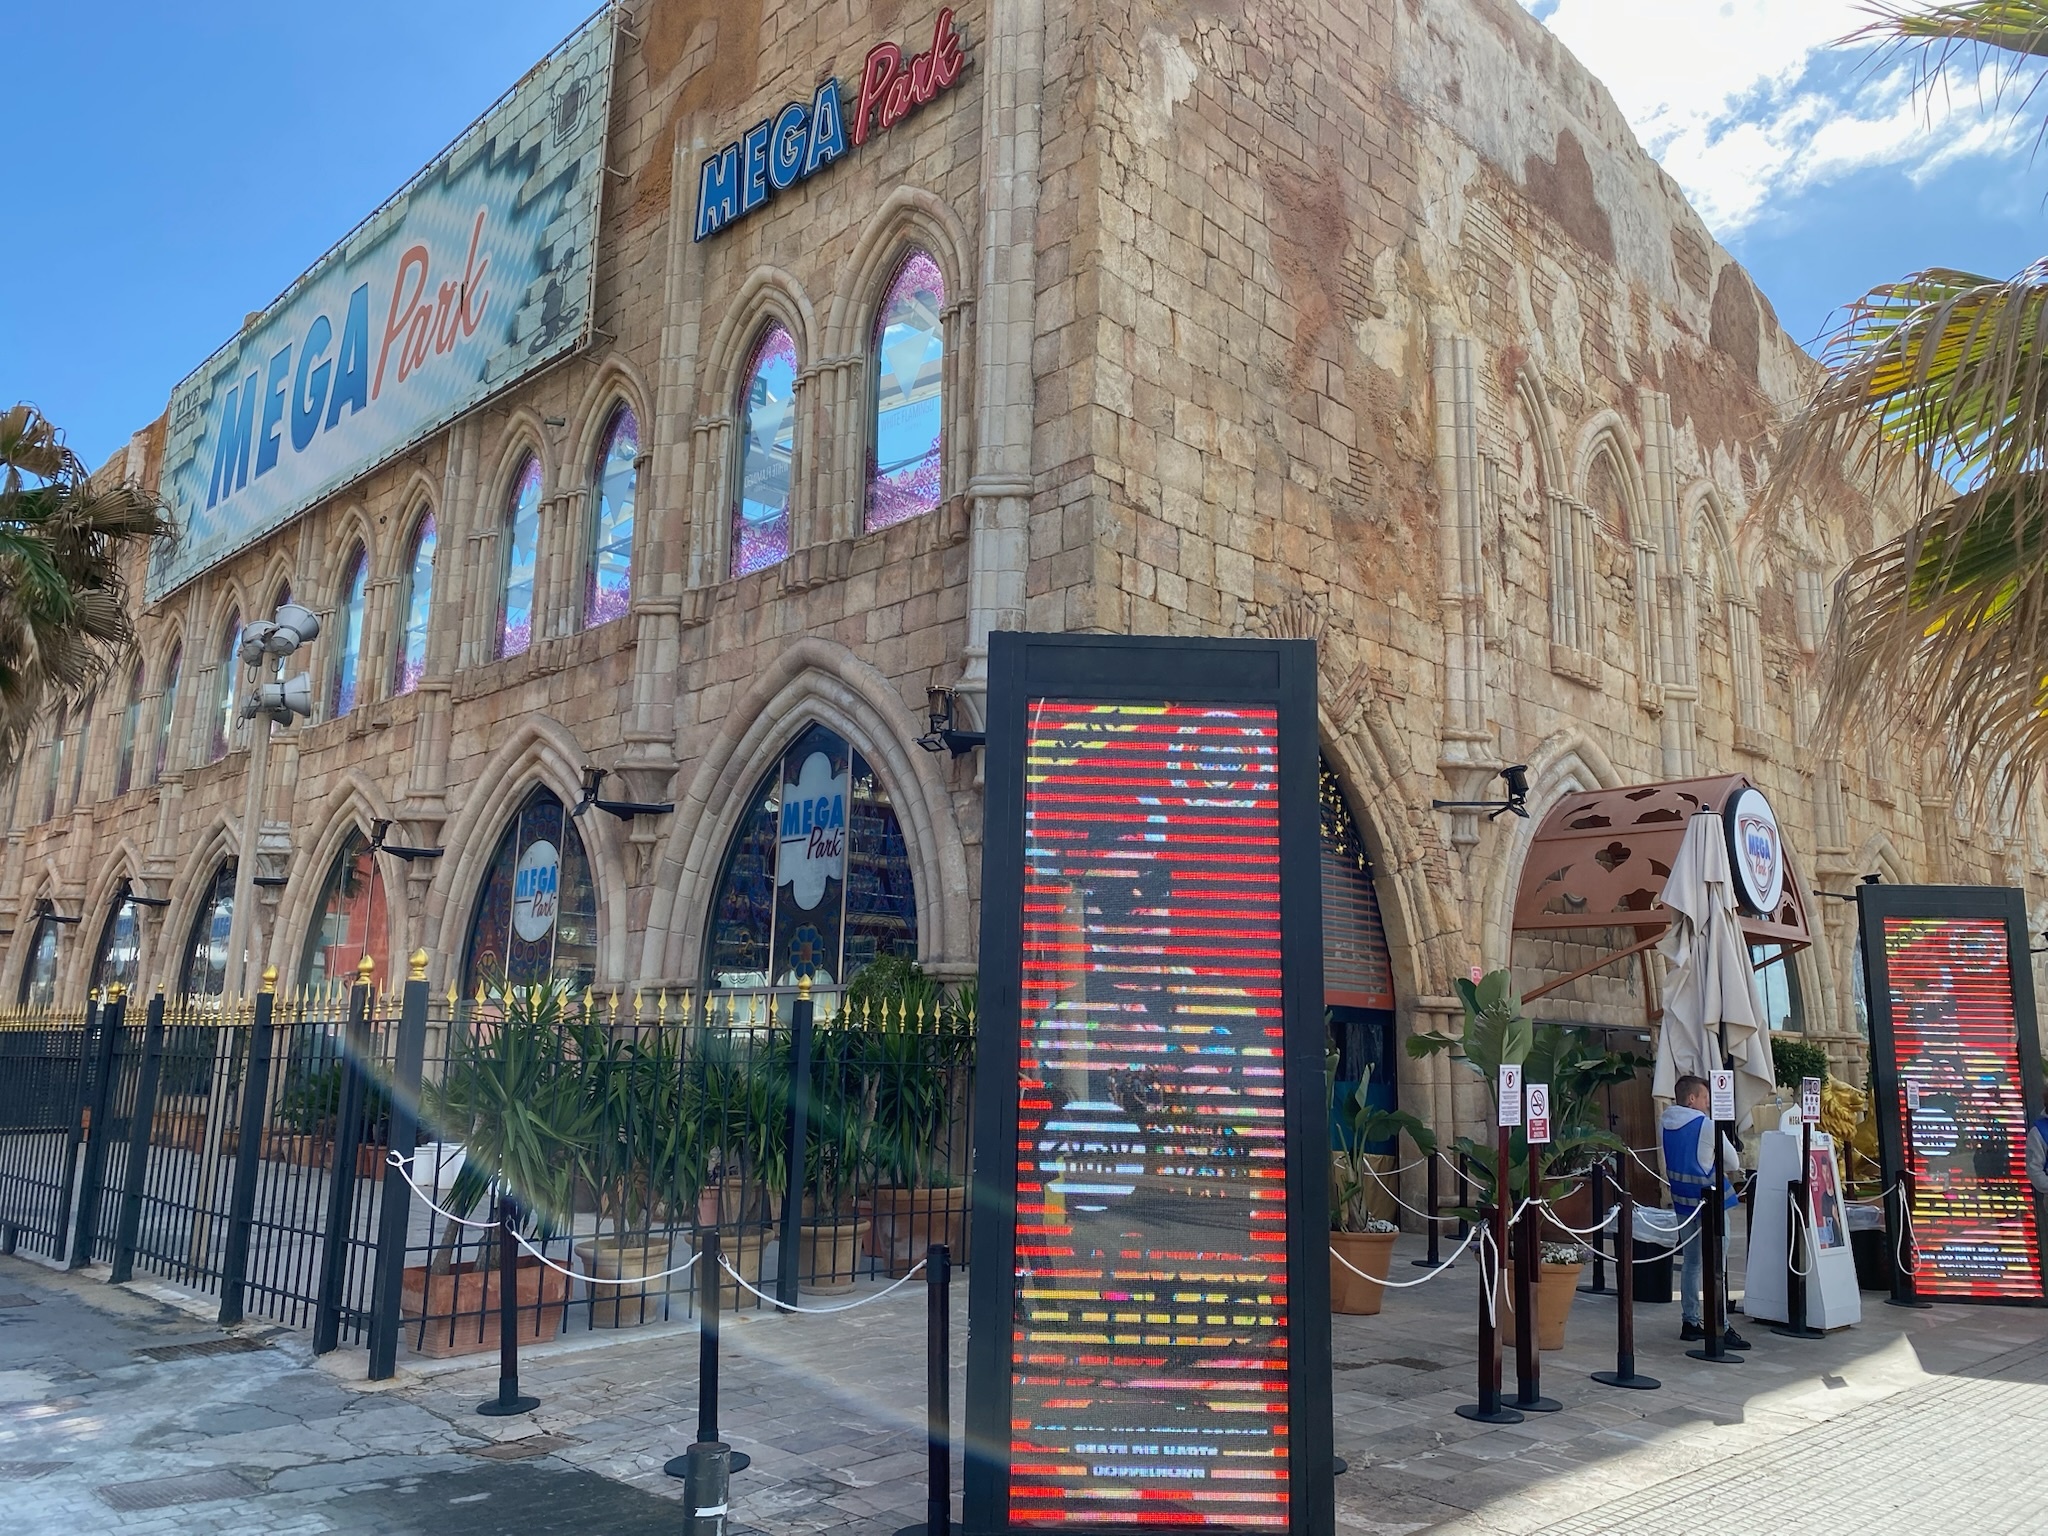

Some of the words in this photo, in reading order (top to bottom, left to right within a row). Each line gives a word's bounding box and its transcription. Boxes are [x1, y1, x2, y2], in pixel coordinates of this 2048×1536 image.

[694, 76, 848, 243] MEGA
[852, 7, 964, 146] Park
[206, 281, 369, 512] MEGA
[372, 211, 488, 401] Park
[177, 385, 200, 419] LIVE
[782, 794, 844, 836] MEGA
[807, 826, 842, 860] Park
[1748, 833, 1771, 860] MEGA
[516, 865, 557, 897] MEGA
[531, 890, 554, 918] Park
